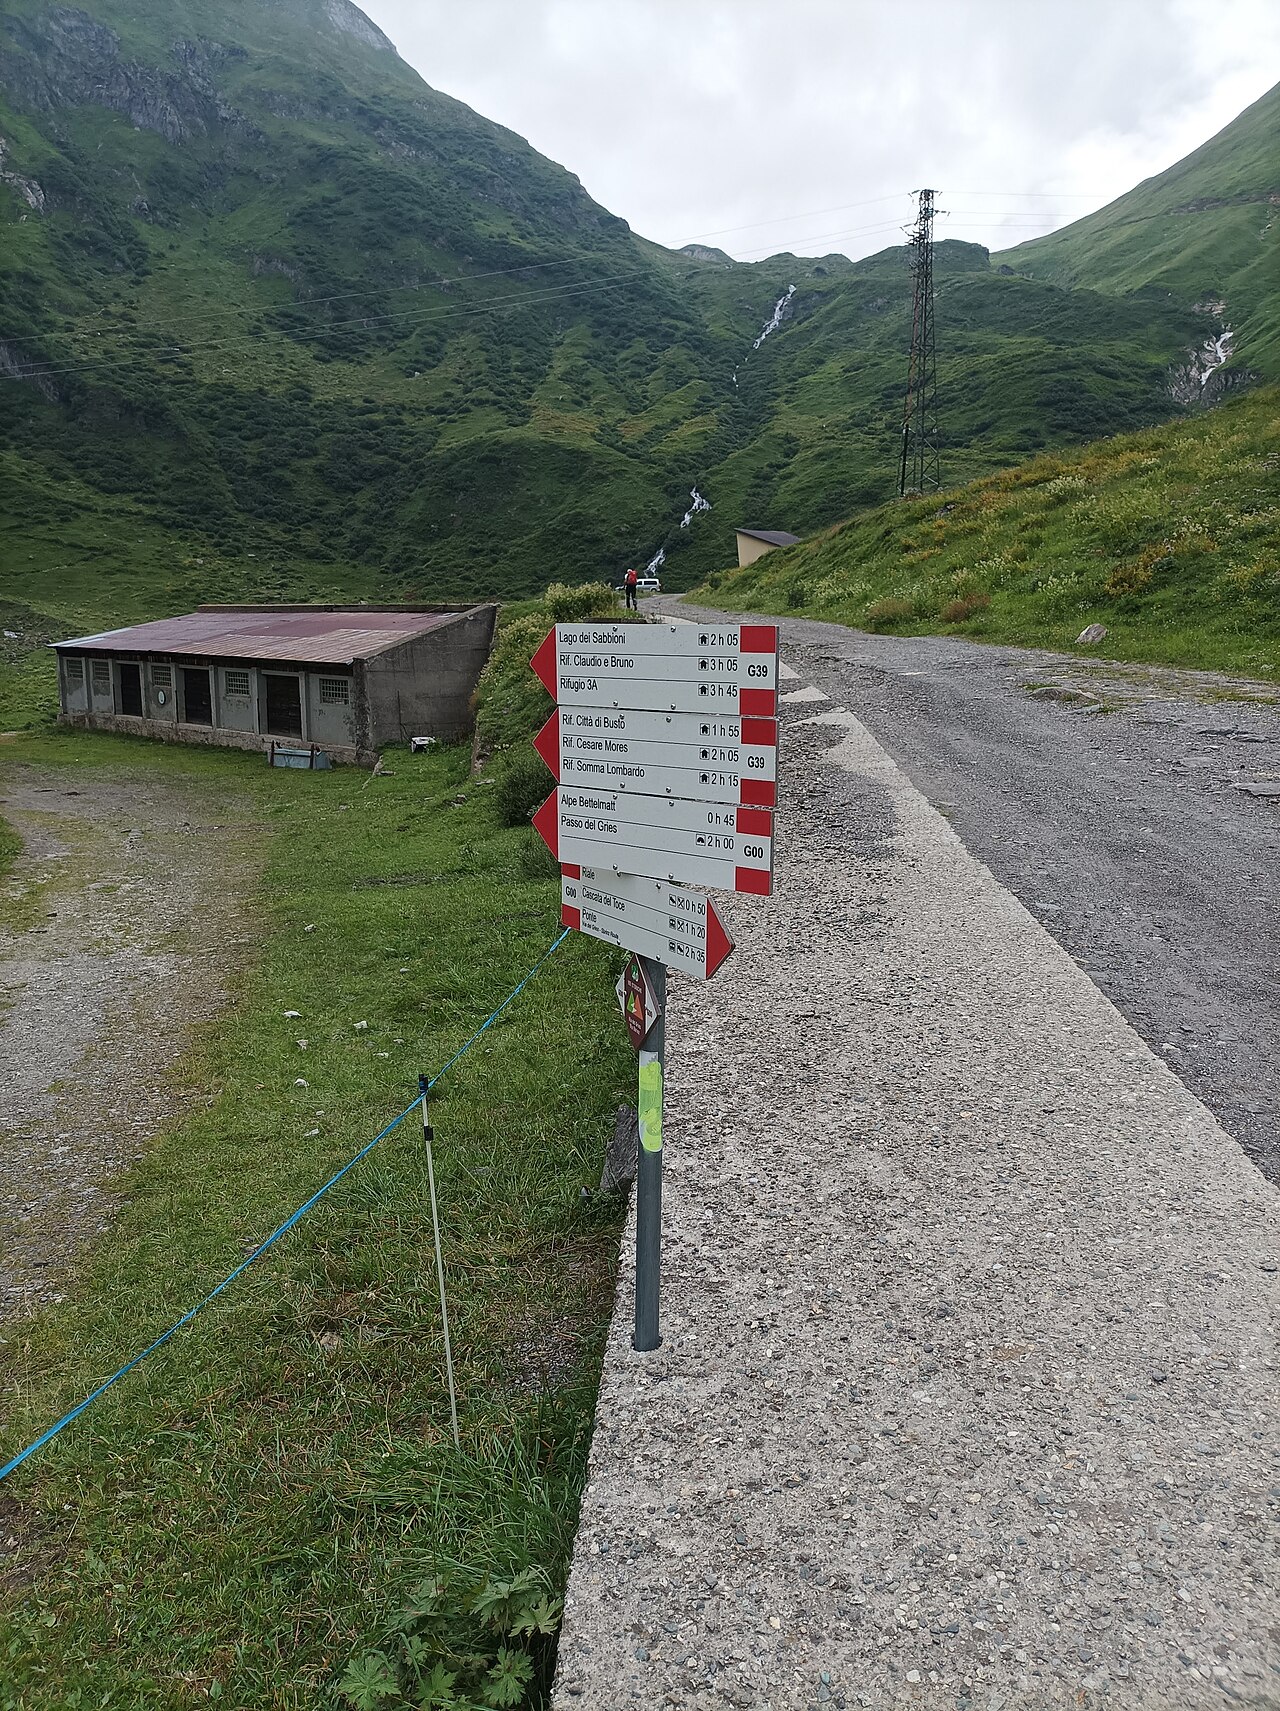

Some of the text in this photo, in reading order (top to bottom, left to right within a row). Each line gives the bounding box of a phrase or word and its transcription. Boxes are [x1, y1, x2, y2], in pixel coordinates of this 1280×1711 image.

[559, 632, 626, 646] Lago dei Sabbioni
[710, 634, 738, 646] 2 h 05
[560, 654, 634, 668] Rif. Claudio e Bruno
[710, 658, 738, 672] 3 h 05
[748, 664, 768, 678] G39
[560, 678, 598, 692] Rifugio 3A
[710, 684, 738, 698] 3 h 45
[562, 714, 626, 730] Rif. Città di Busto
[712, 724, 740, 738] 1 h 55
[562, 736, 628, 752] Rif. Cesare Mores
[712, 748, 738, 762] 2 h 05
[747, 756, 764, 768] G39
[562, 759, 644, 778] Rif. Somma Lombardo
[711, 773, 738, 786] 2 h 15
[561, 794, 616, 811] Alpe Bettelmatt
[561, 816, 618, 834] Passo del Gries
[708, 812, 734, 826] 0 h 45
[708, 836, 734, 850] 2 h 00
[744, 845, 764, 858] G00
[582, 888, 626, 912] Cascata del Toce
[686, 899, 706, 916] 0 h 50
[582, 908, 597, 923] Ponte
[686, 922, 706, 939] 1 h 20
[685, 946, 706, 963] 2 h 35
